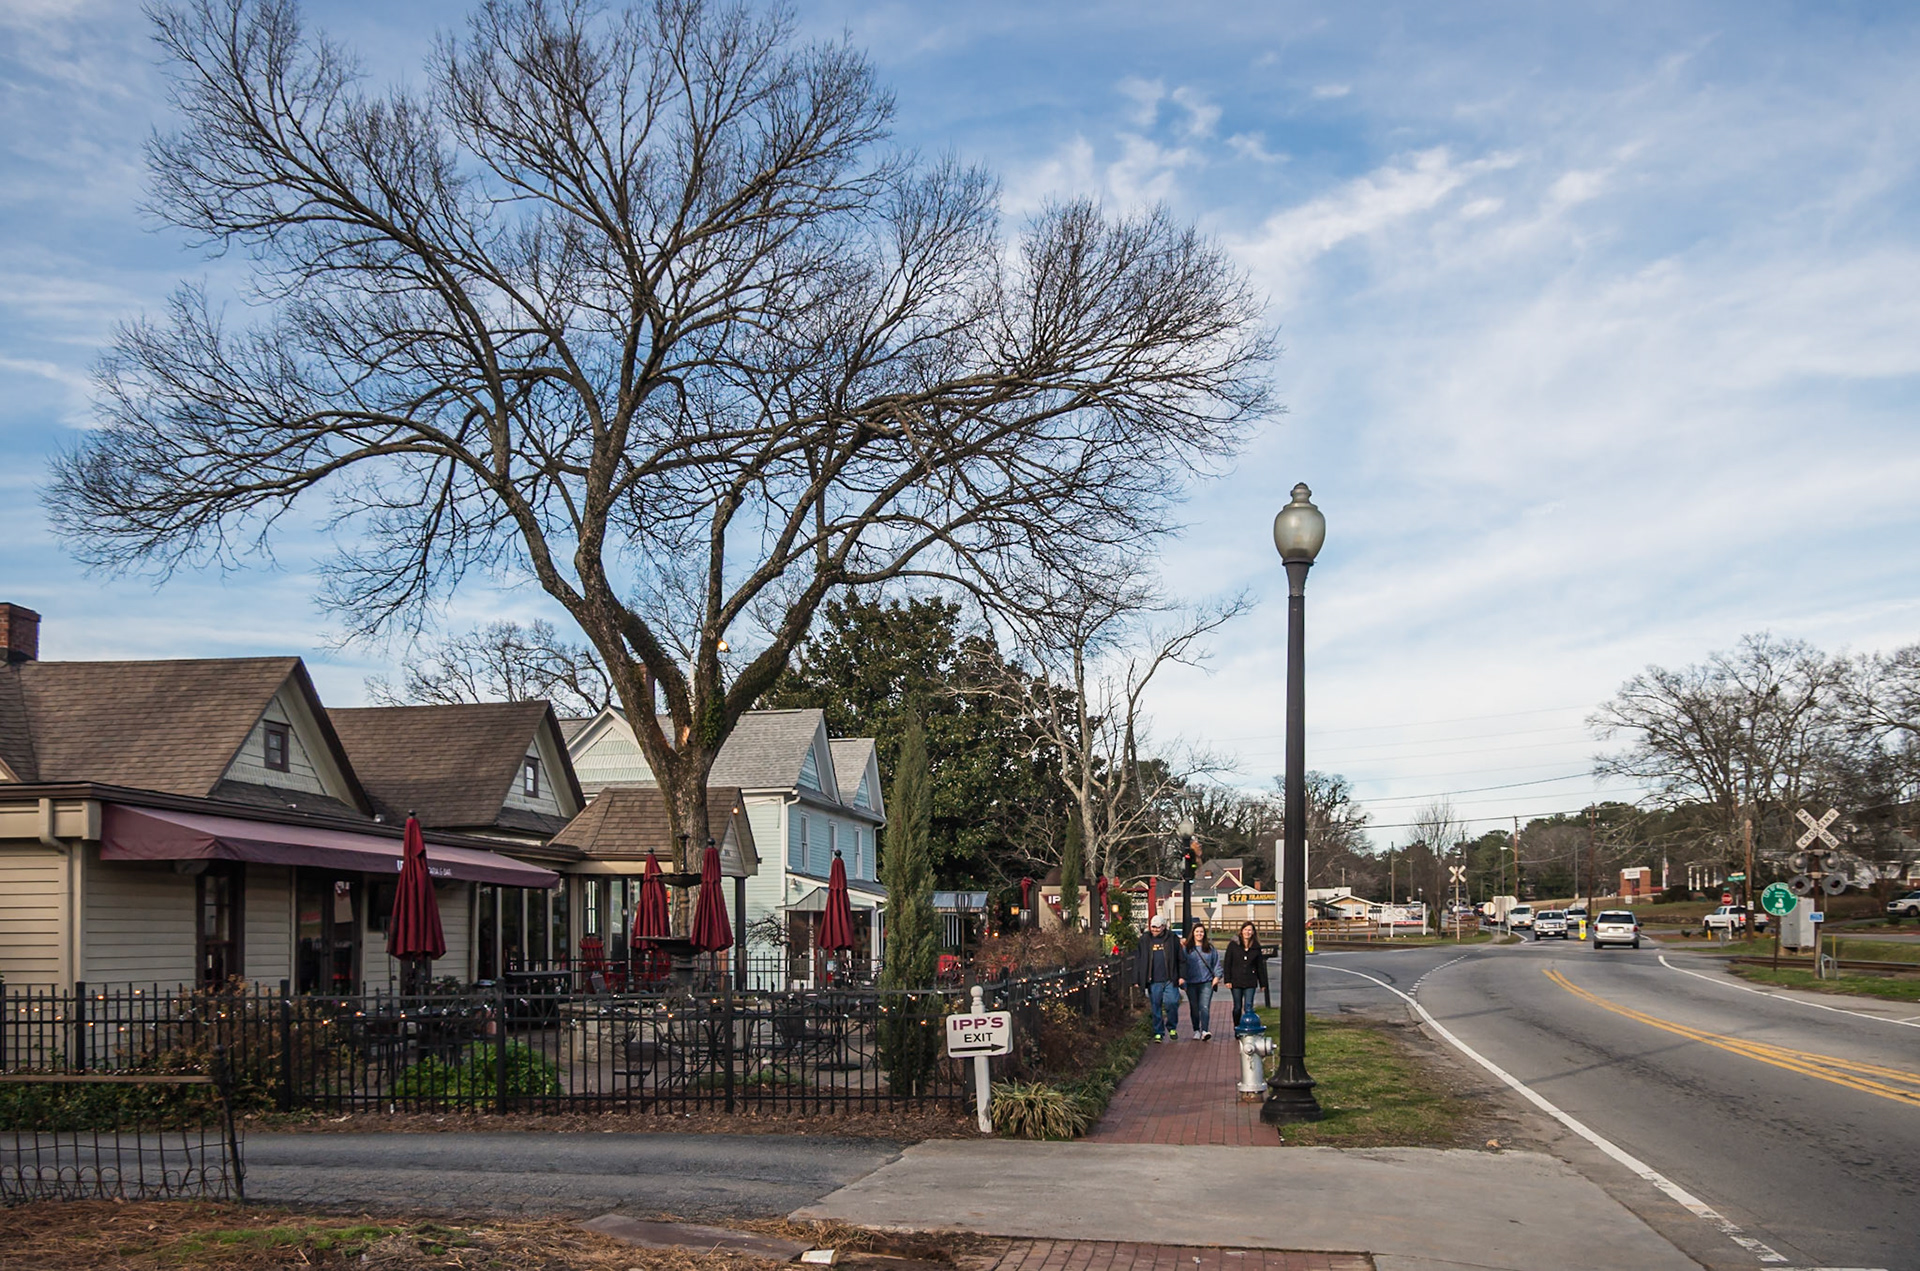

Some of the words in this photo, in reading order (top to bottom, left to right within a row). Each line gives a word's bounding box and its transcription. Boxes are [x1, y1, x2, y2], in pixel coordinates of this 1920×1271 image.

[1798, 811, 1813, 827] RAIL
[1821, 831, 1837, 846] ROAD
[953, 1017, 1004, 1031] IPP'S
[964, 1032, 993, 1043] EXIT
